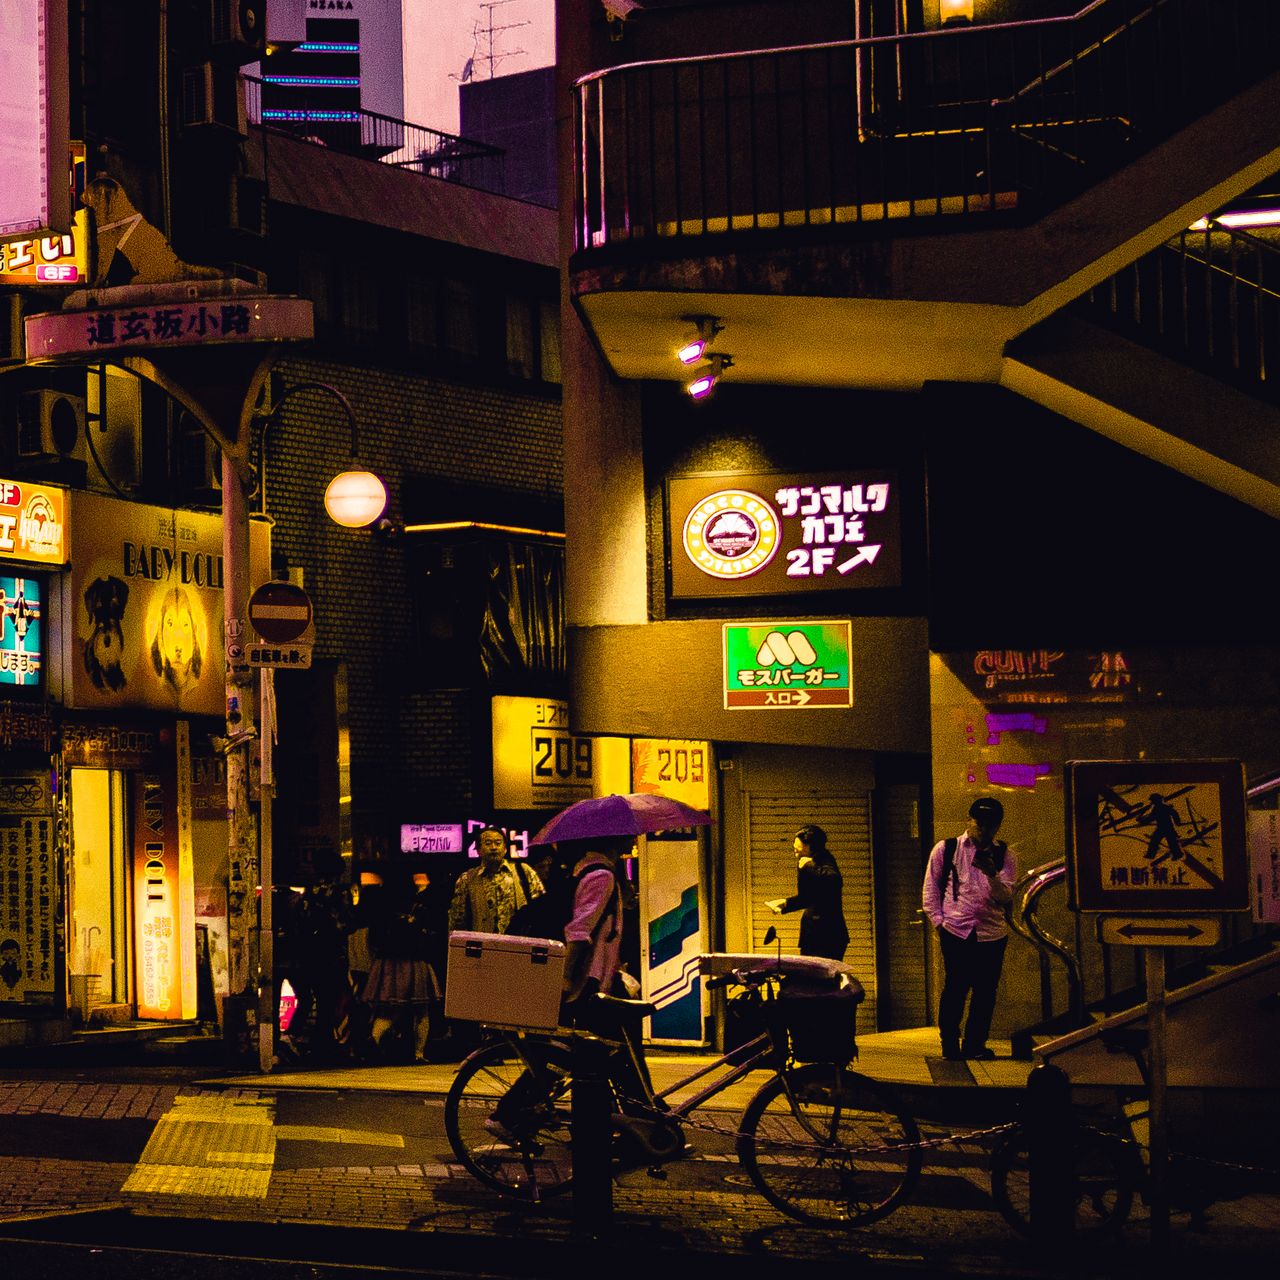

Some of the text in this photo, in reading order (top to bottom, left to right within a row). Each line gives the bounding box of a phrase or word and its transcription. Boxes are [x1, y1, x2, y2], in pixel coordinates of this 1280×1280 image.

[87, 306, 251, 346] 道玄坂小路
[775, 483, 889, 516] サンマルク
[801, 513, 866, 545] カフェ
[124, 542, 175, 582] BABY
[786, 548, 837, 577] 2F
[251, 648, 307, 666] 自転車を除く
[737, 669, 840, 687] モスバーガー
[764, 692, 791, 705] 入口
[534, 737, 593, 778] 209
[657, 748, 705, 783] 209
[1109, 867, 1190, 887] 横断禁止
